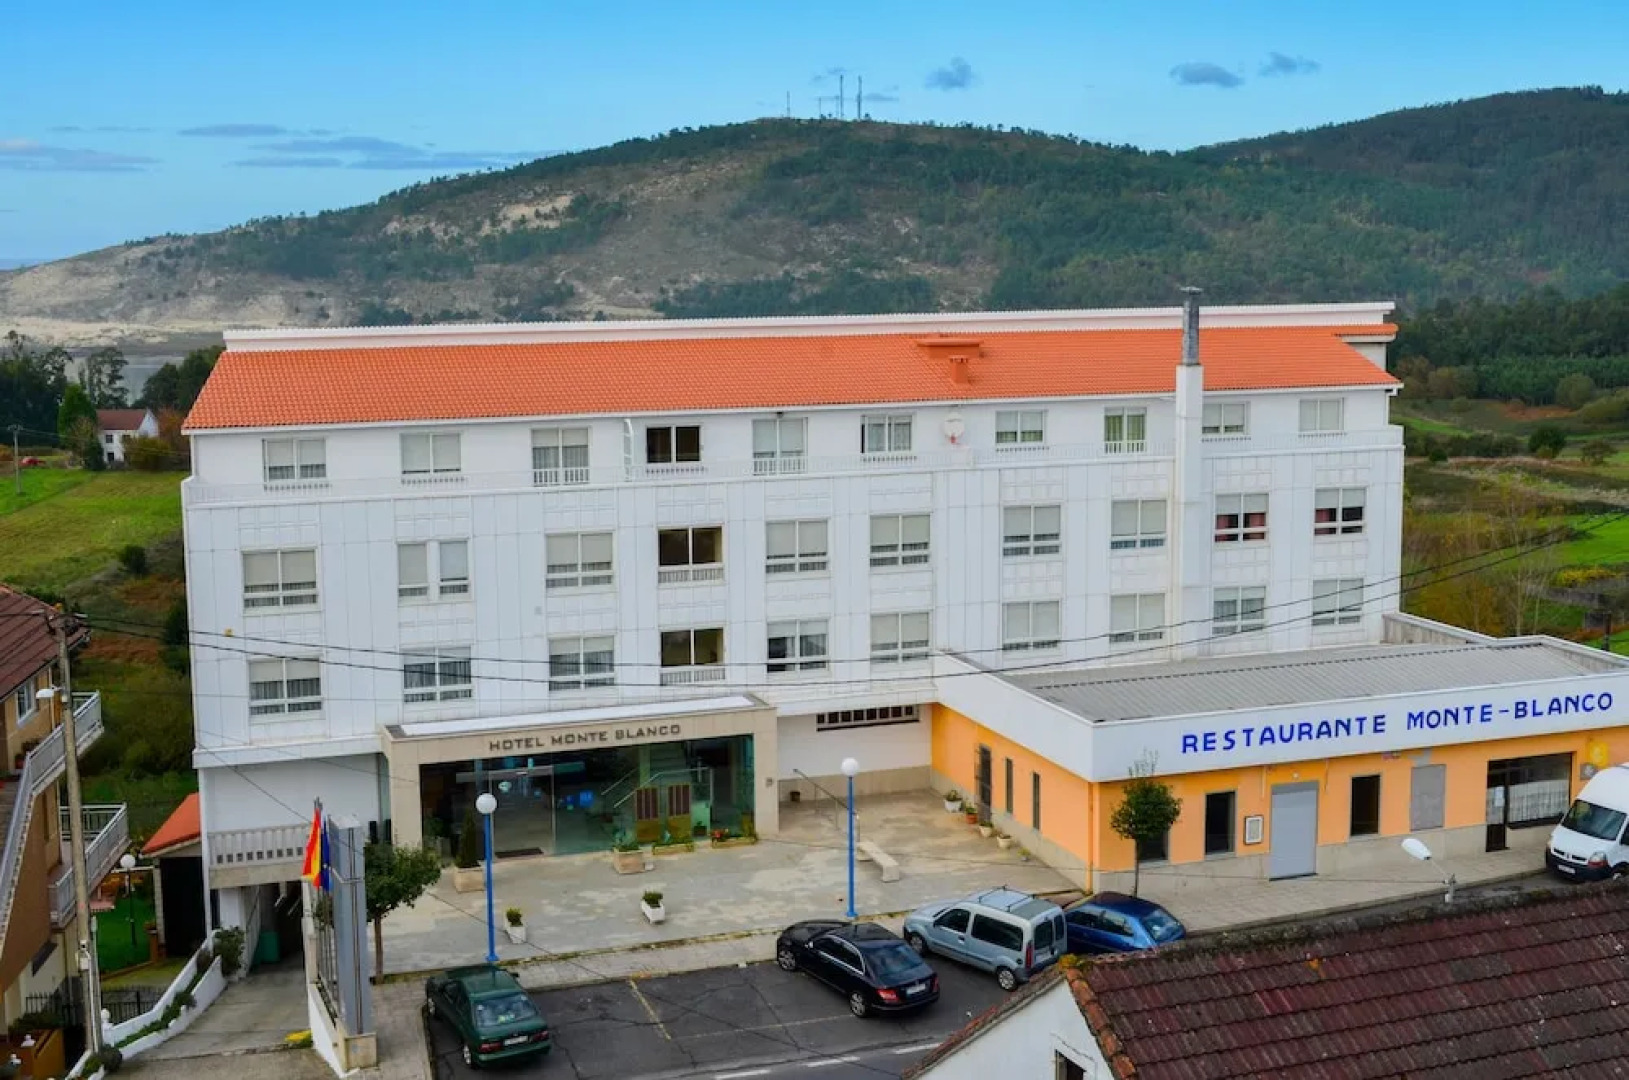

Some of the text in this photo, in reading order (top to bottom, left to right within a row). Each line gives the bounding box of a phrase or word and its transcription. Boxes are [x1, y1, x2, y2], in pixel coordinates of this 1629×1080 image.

[489, 724, 681, 751] HOTEL MONTE BLANCO
[1181, 692, 1613, 754] RESTAURANTE MONTE-BLANCO
